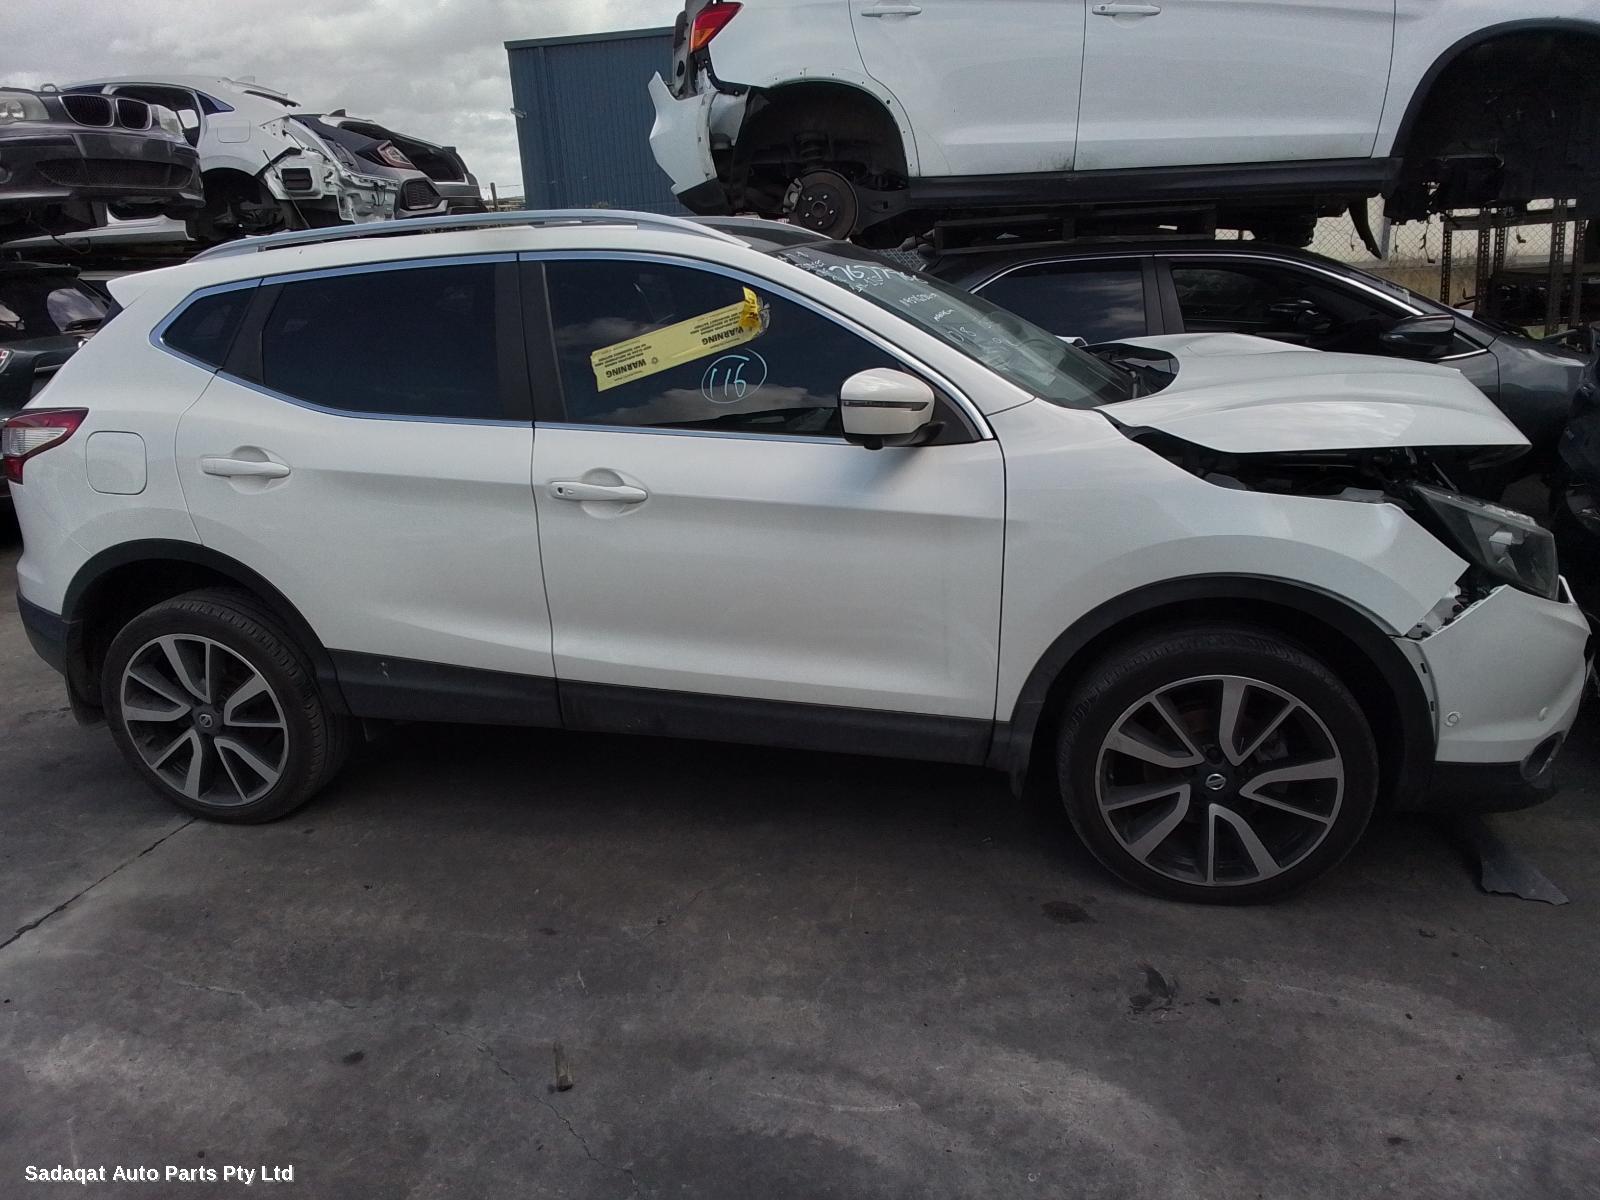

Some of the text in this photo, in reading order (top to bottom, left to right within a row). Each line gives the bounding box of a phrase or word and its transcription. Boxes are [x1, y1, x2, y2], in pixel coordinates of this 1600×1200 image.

[701, 325, 744, 346] WARNING
[605, 358, 647, 378] WARNING
[709, 362, 747, 398] 116
